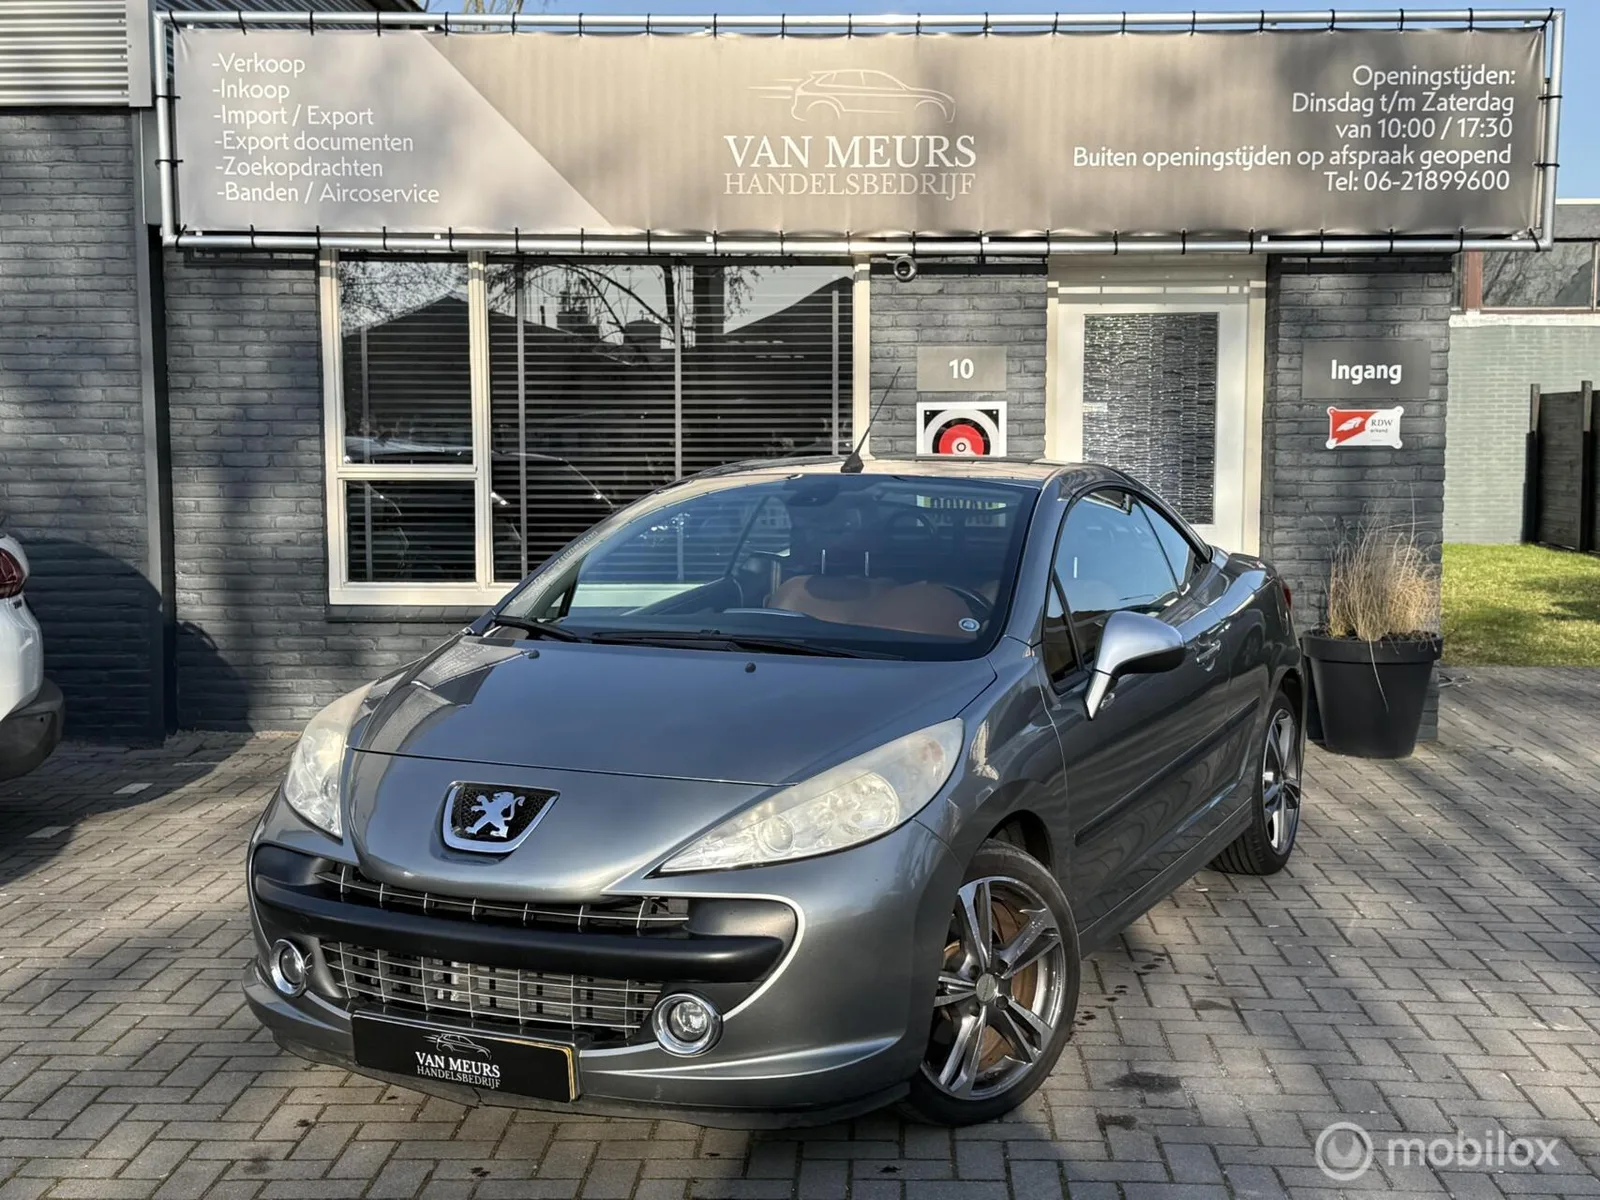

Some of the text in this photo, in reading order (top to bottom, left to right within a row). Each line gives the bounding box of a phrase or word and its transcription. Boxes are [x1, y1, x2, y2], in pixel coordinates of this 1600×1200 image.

[211, 52, 305, 78] -Verkoop
[1352, 63, 1516, 91] Openingstijden:
[212, 78, 290, 103] -Inkoop
[1292, 90, 1515, 117] Dinsdag t/m Zaterdag
[213, 104, 288, 129] -Import
[307, 105, 374, 130] Export
[1335, 124, 1372, 138] van
[1377, 117, 1436, 139] 10:00
[1457, 117, 1513, 138] 17:30
[214, 130, 414, 155] -Export documenten
[723, 134, 977, 168] VAN MEURS
[215, 156, 383, 181] -Zoekopdrachten
[1073, 143, 1512, 171] Buiten openingstijden op afspraak geopend
[217, 181, 299, 202] -Banden
[319, 183, 440, 203] Aircoservice
[723, 172, 976, 201] HANDELSBEDRIJF
[1323, 170, 1510, 191] Tel: 06-21899600
[949, 358, 974, 379] 10
[1331, 359, 1402, 385] Ingang
[415, 1051, 501, 1078] VAN MEURS
[416, 1064, 501, 1090] HANDELSBEDRIJF
